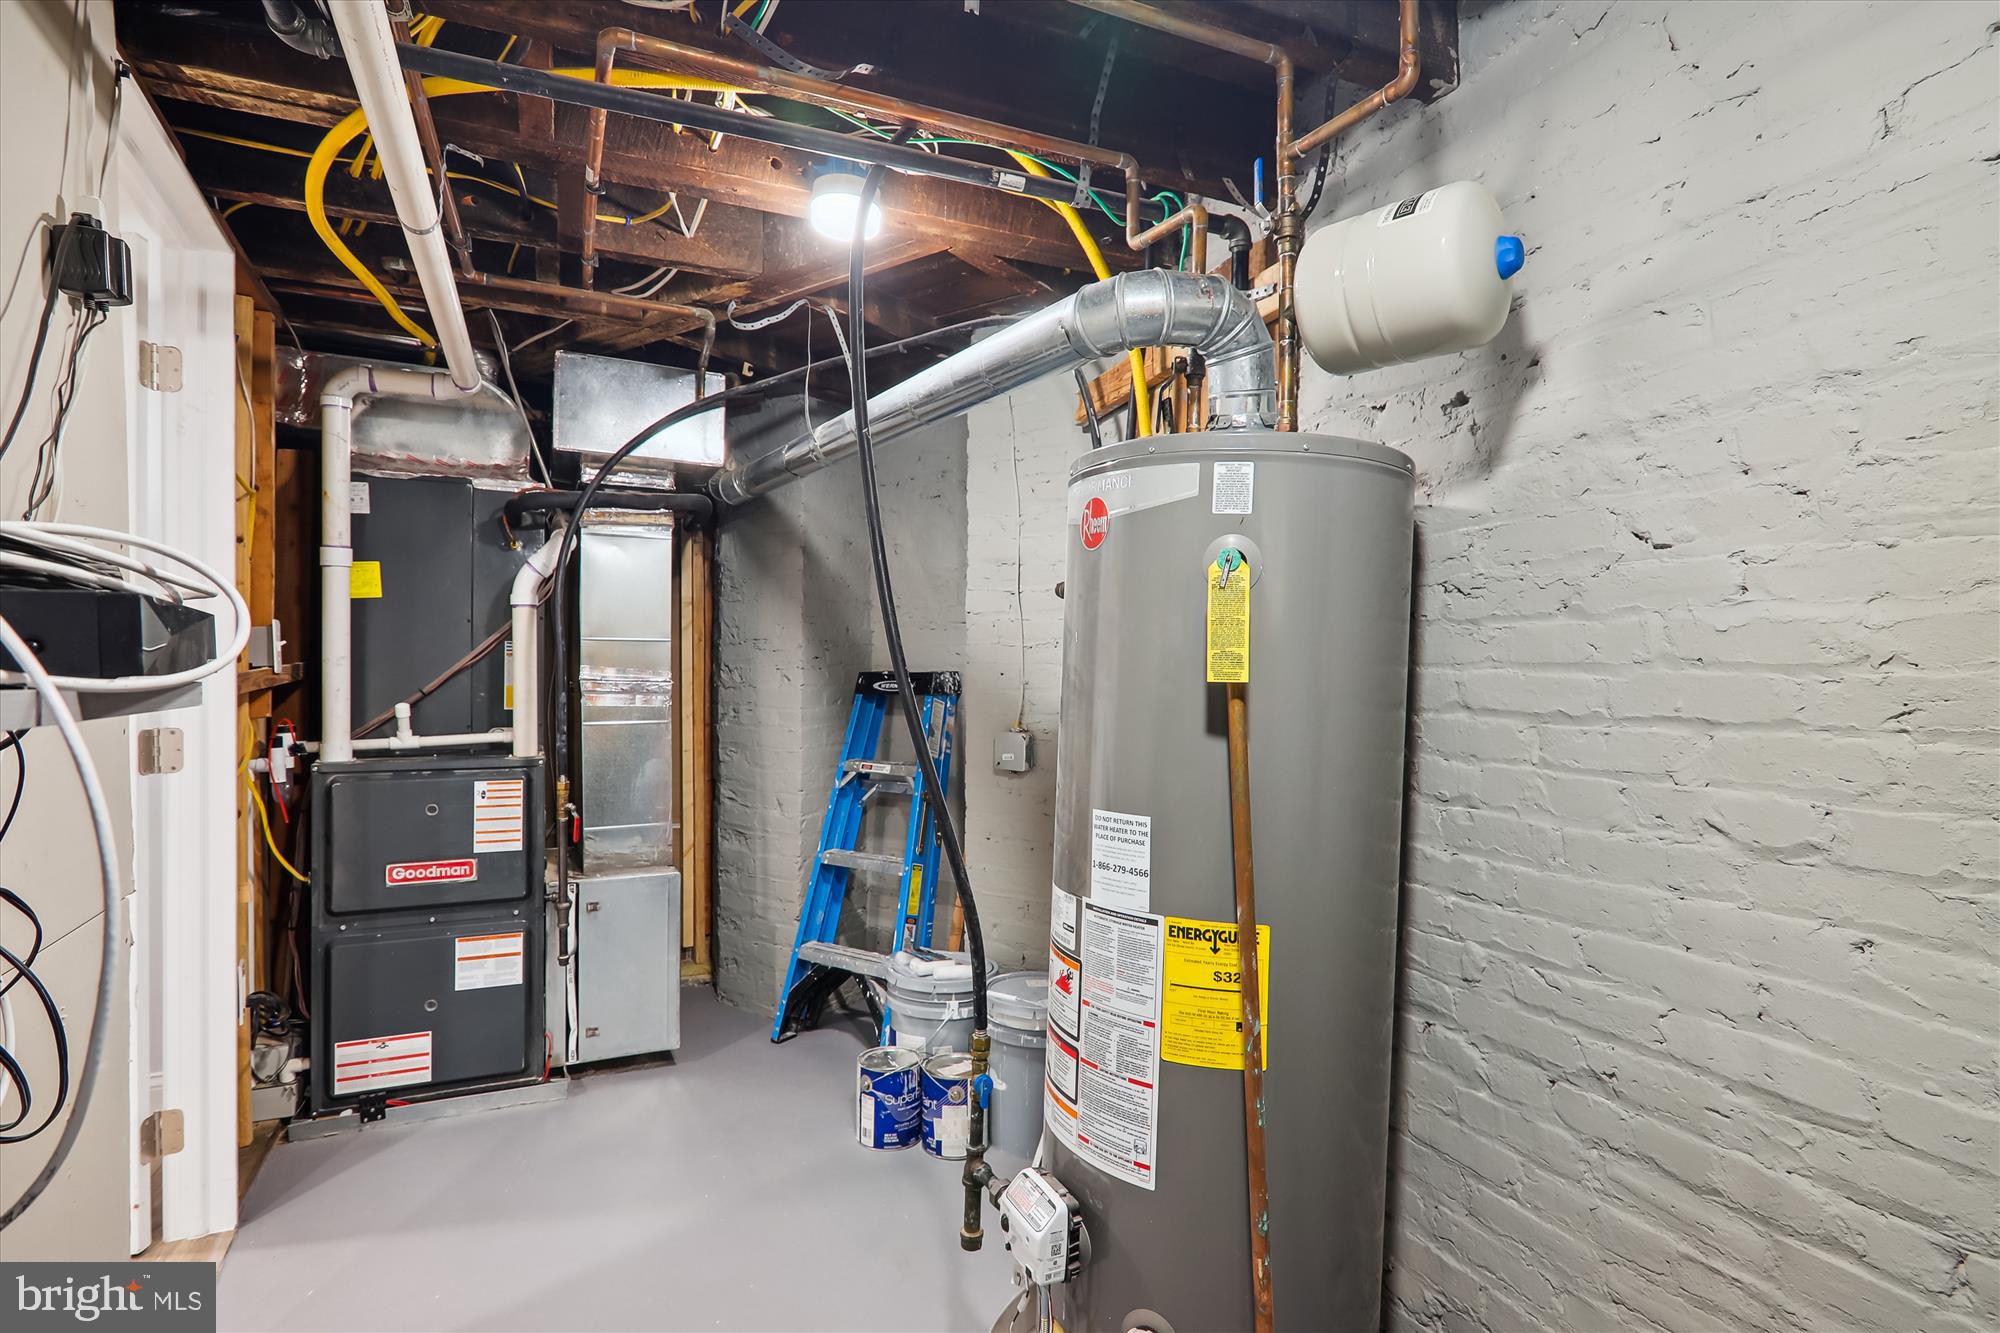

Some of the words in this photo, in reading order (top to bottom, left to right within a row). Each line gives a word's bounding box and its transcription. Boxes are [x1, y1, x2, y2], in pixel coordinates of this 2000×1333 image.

[1081, 500, 1108, 541] Rheem
[1109, 826, 1129, 835] HEATER
[1113, 818, 1134, 827] RETURN
[1135, 821, 1148, 829] THIS
[1095, 833, 1109, 841] PLACE
[1117, 837, 1146, 847] PURCHASE
[392, 865, 470, 880] Goodman
[1092, 860, 1149, 878] 1-866-279-4566
[1168, 925, 1259, 946] ENERGYGU
